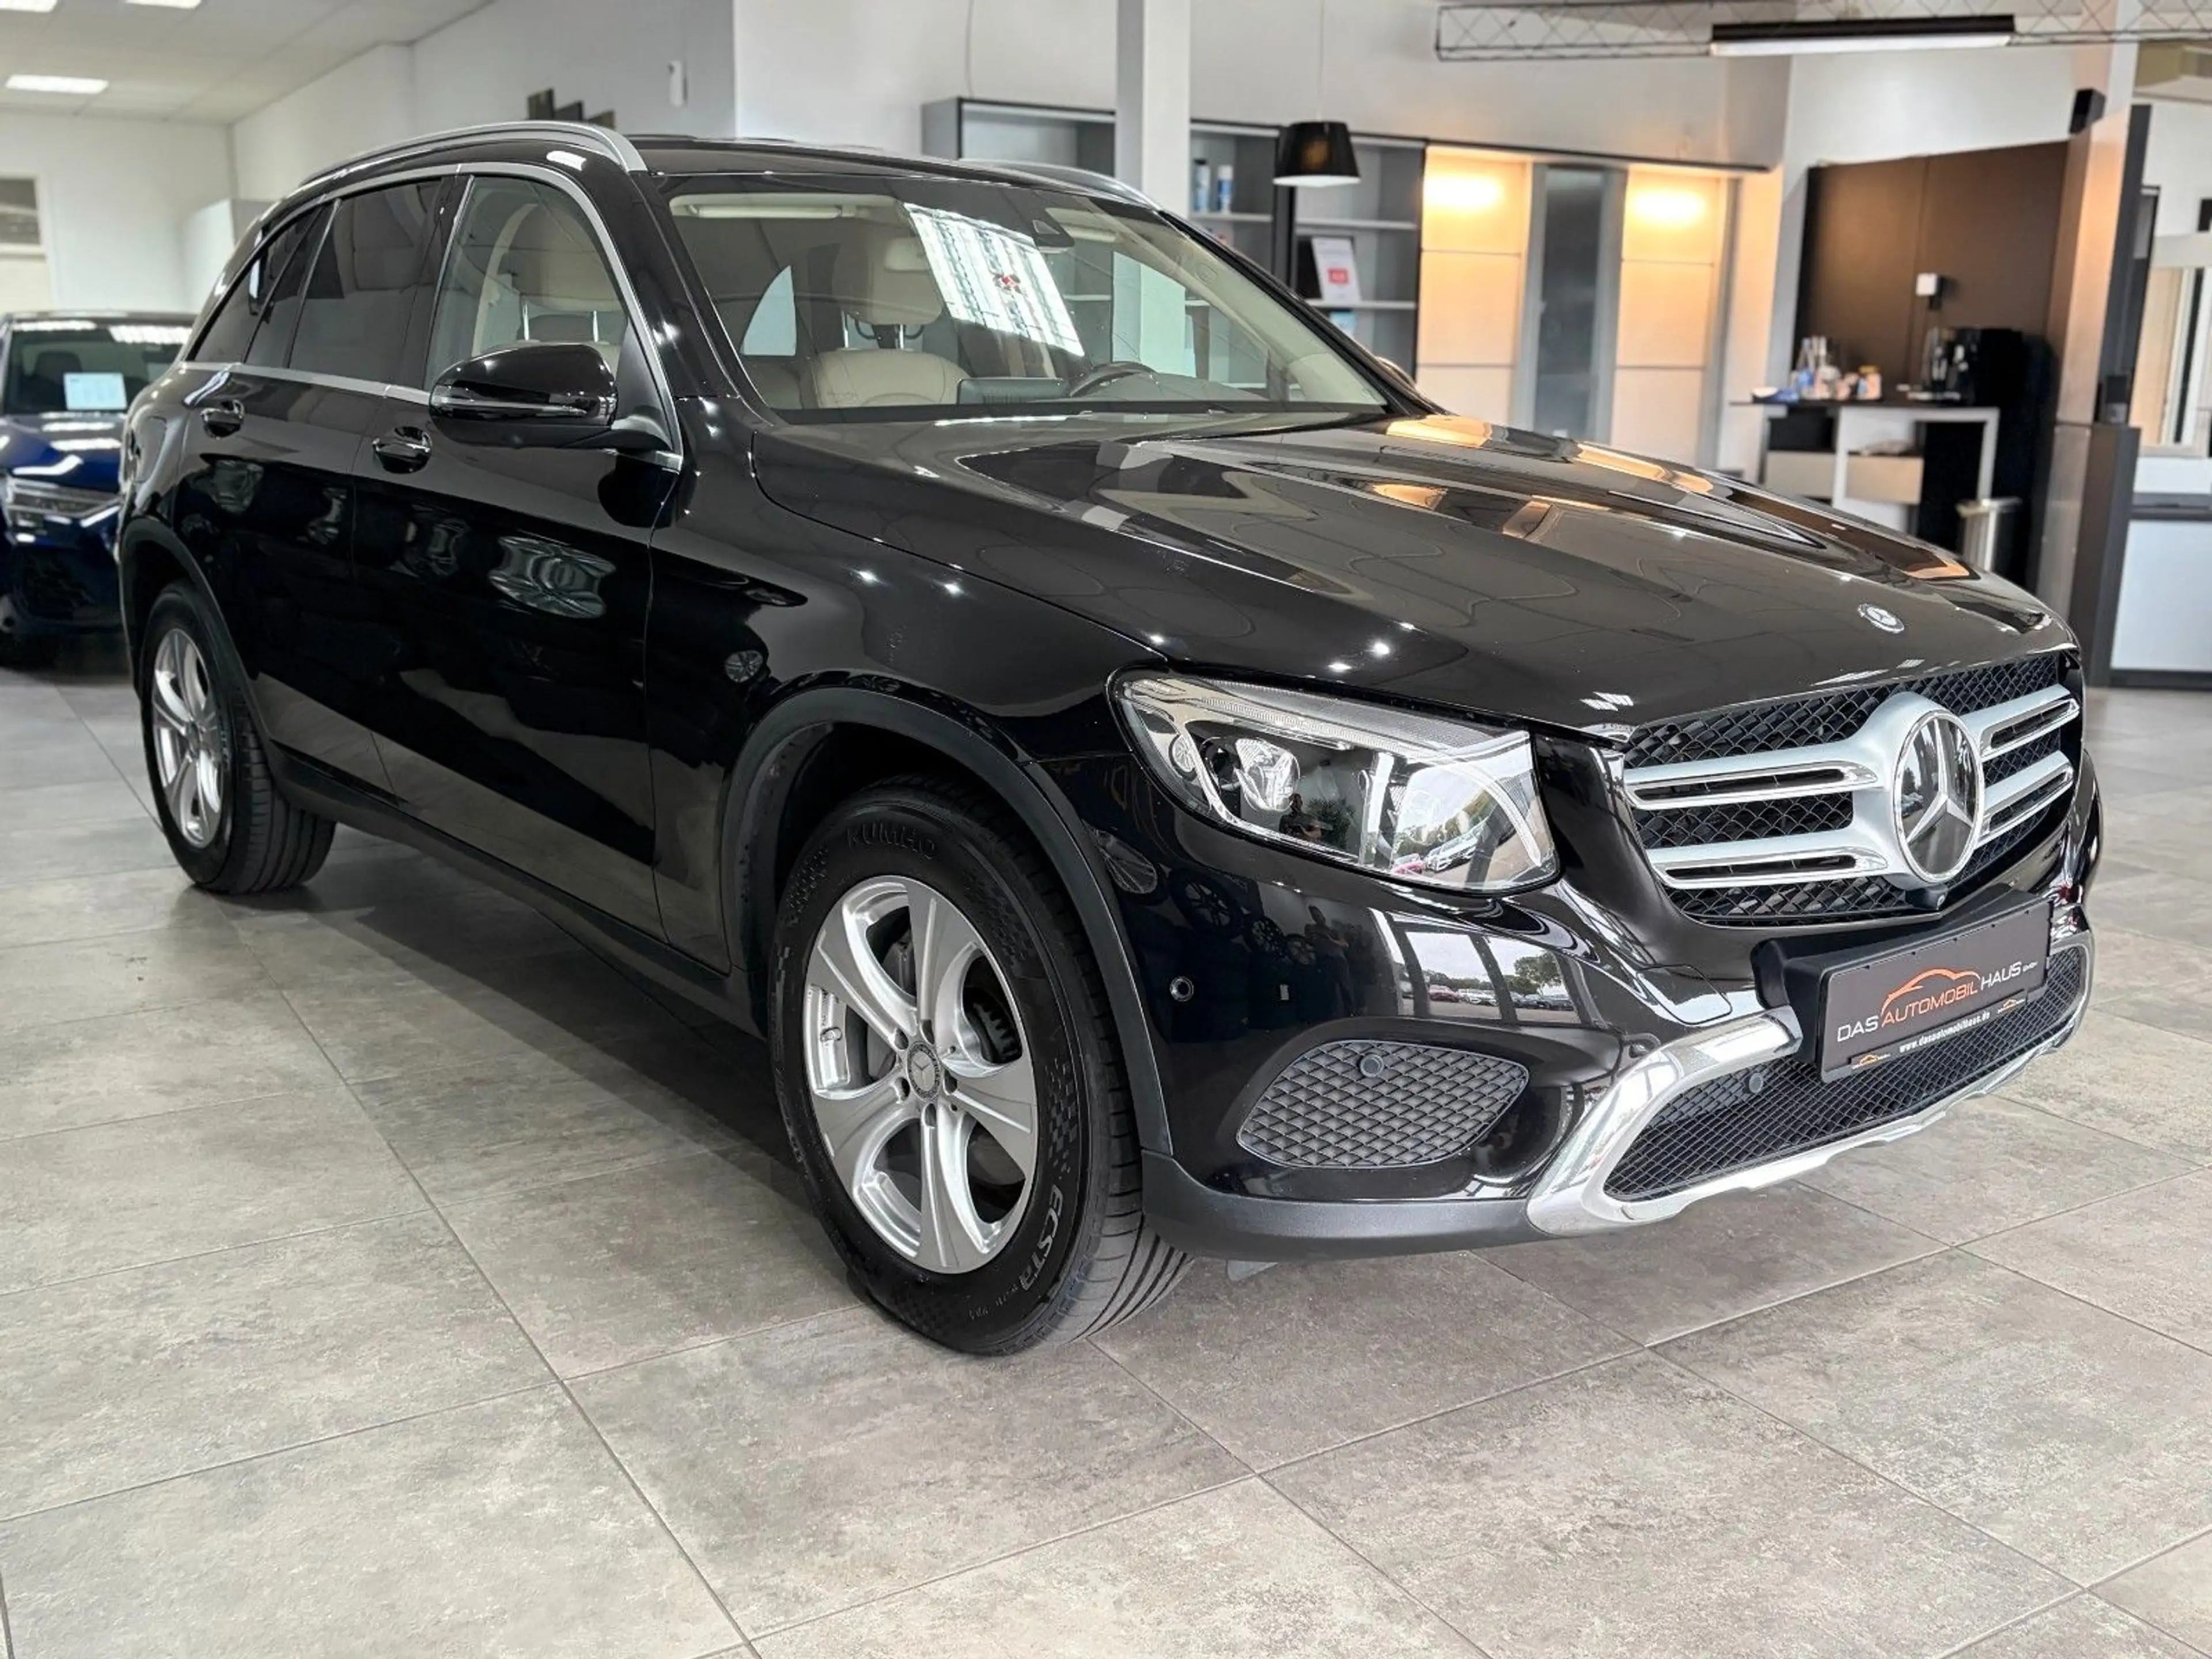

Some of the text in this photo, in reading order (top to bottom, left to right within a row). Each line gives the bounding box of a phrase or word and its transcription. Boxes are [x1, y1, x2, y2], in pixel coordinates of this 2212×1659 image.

[1837, 1014, 1880, 1042] DAS
[1881, 981, 1978, 1028] AUTOMOBIL
[1980, 960, 2022, 991] HAUS
[1018, 1184, 1063, 1290] ECSTA
